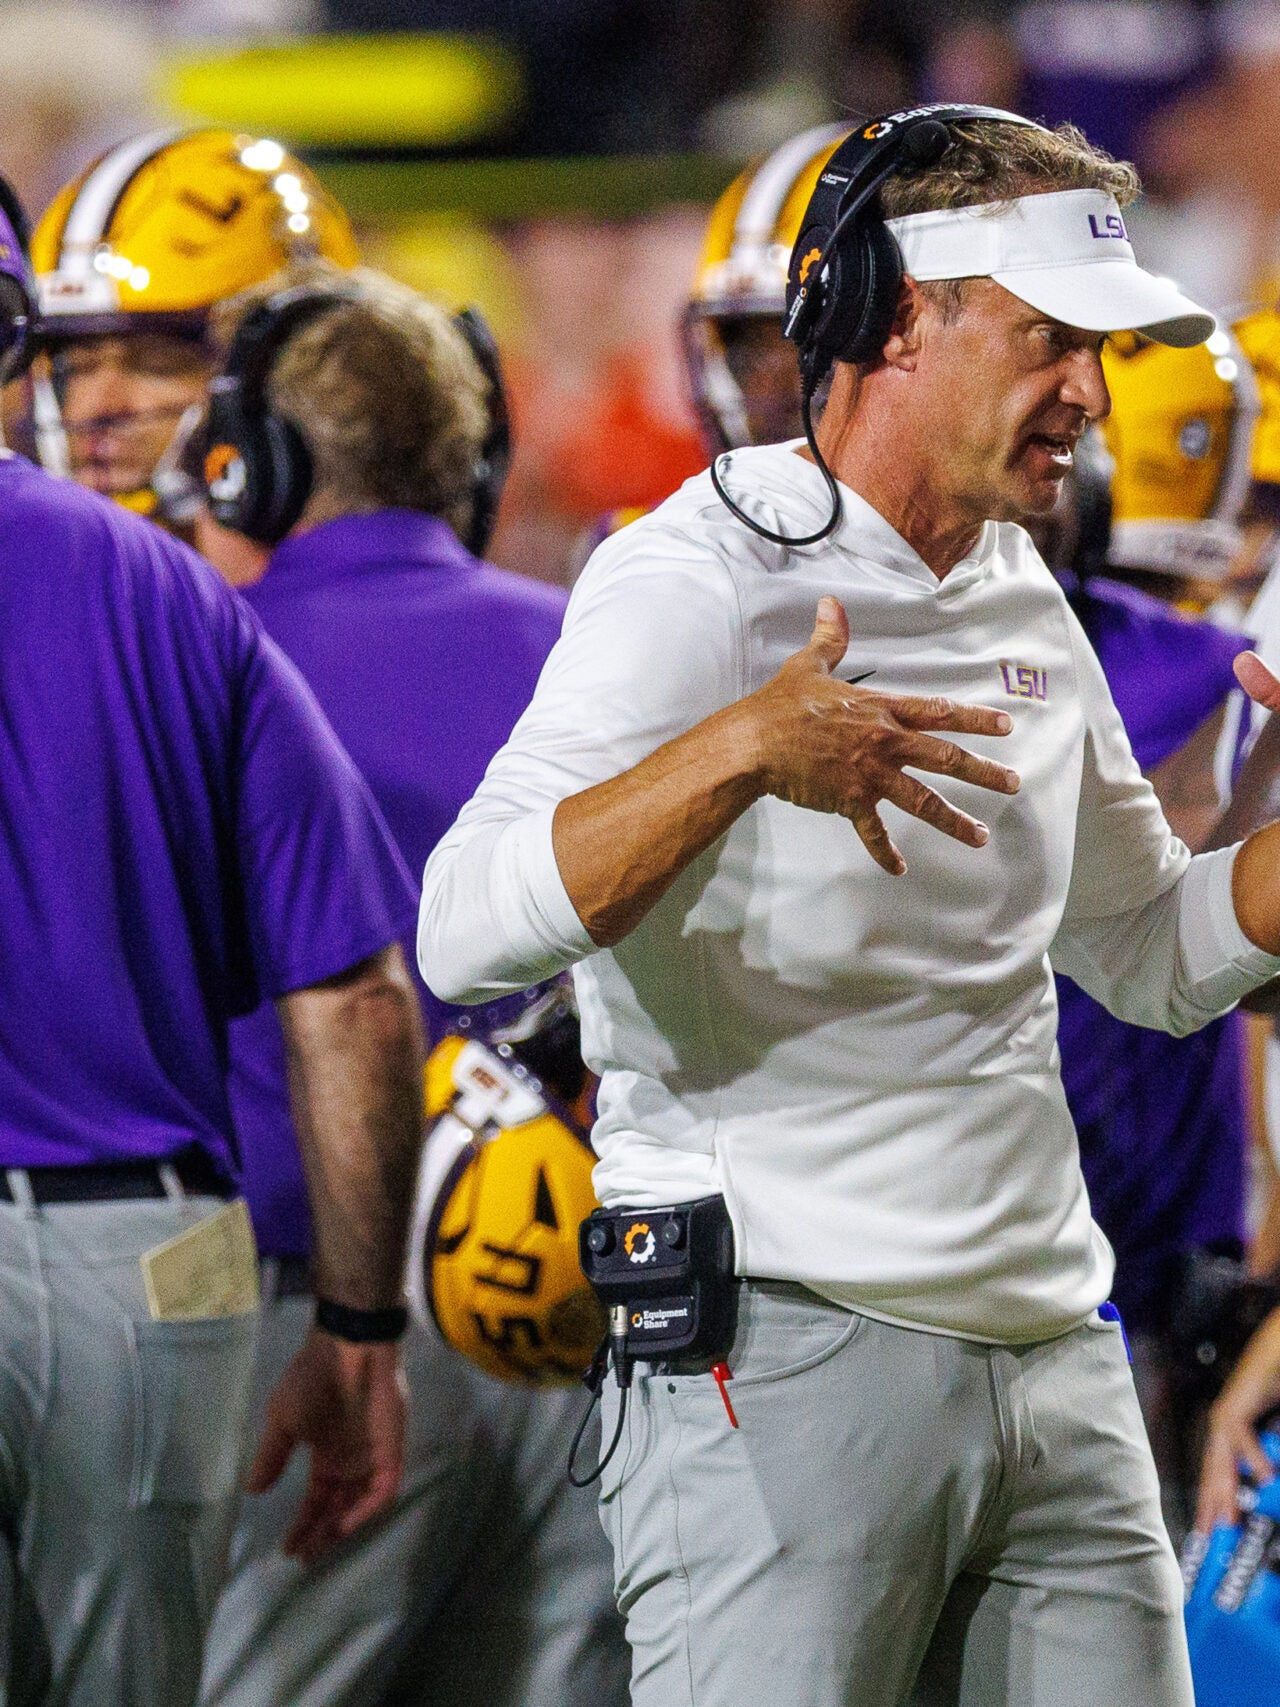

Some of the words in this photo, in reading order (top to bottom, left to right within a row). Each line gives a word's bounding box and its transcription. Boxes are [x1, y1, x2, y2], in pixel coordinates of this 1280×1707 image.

[999, 662, 1046, 701] LSU
[643, 1308, 688, 1320] Equipment
[643, 1320, 668, 1329] Share
